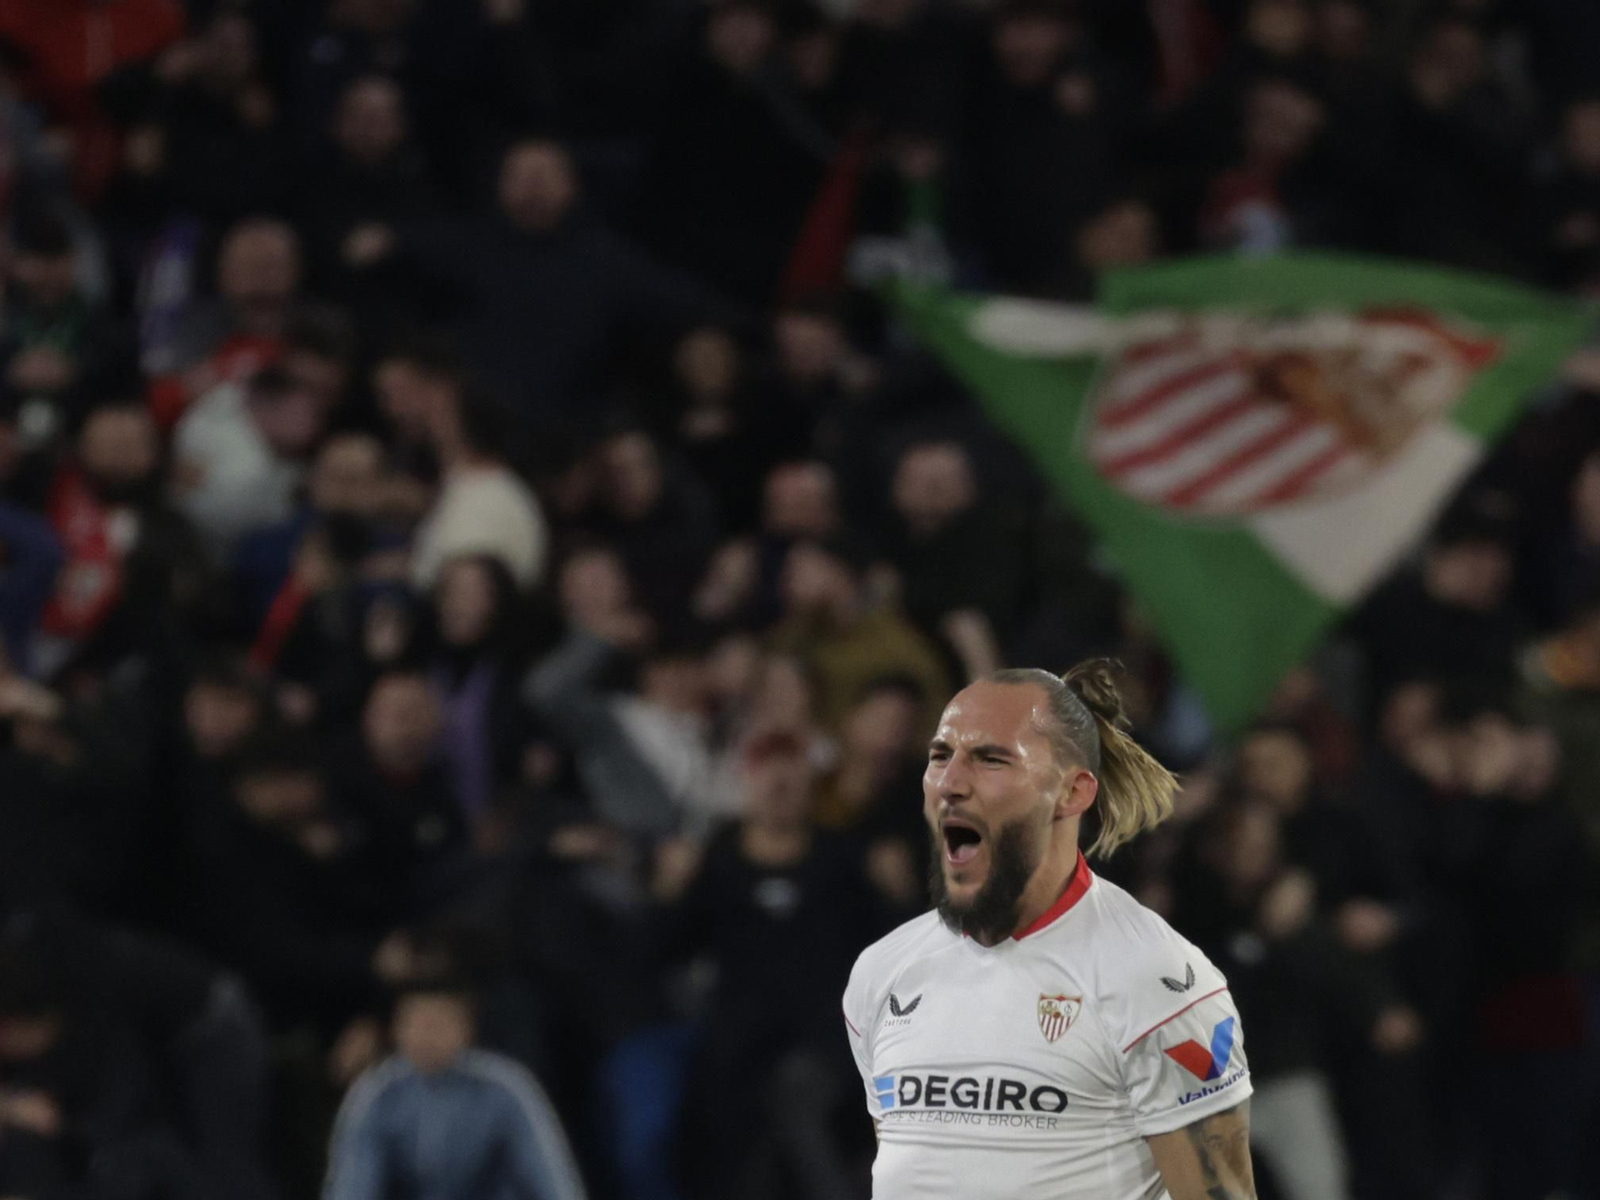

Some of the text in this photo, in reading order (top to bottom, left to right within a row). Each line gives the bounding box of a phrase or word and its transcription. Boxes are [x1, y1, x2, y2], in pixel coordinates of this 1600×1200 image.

[899, 1075, 1069, 1113] DEGIRO
[919, 1111, 982, 1126] LEADING
[988, 1113, 1058, 1130] BROKER
